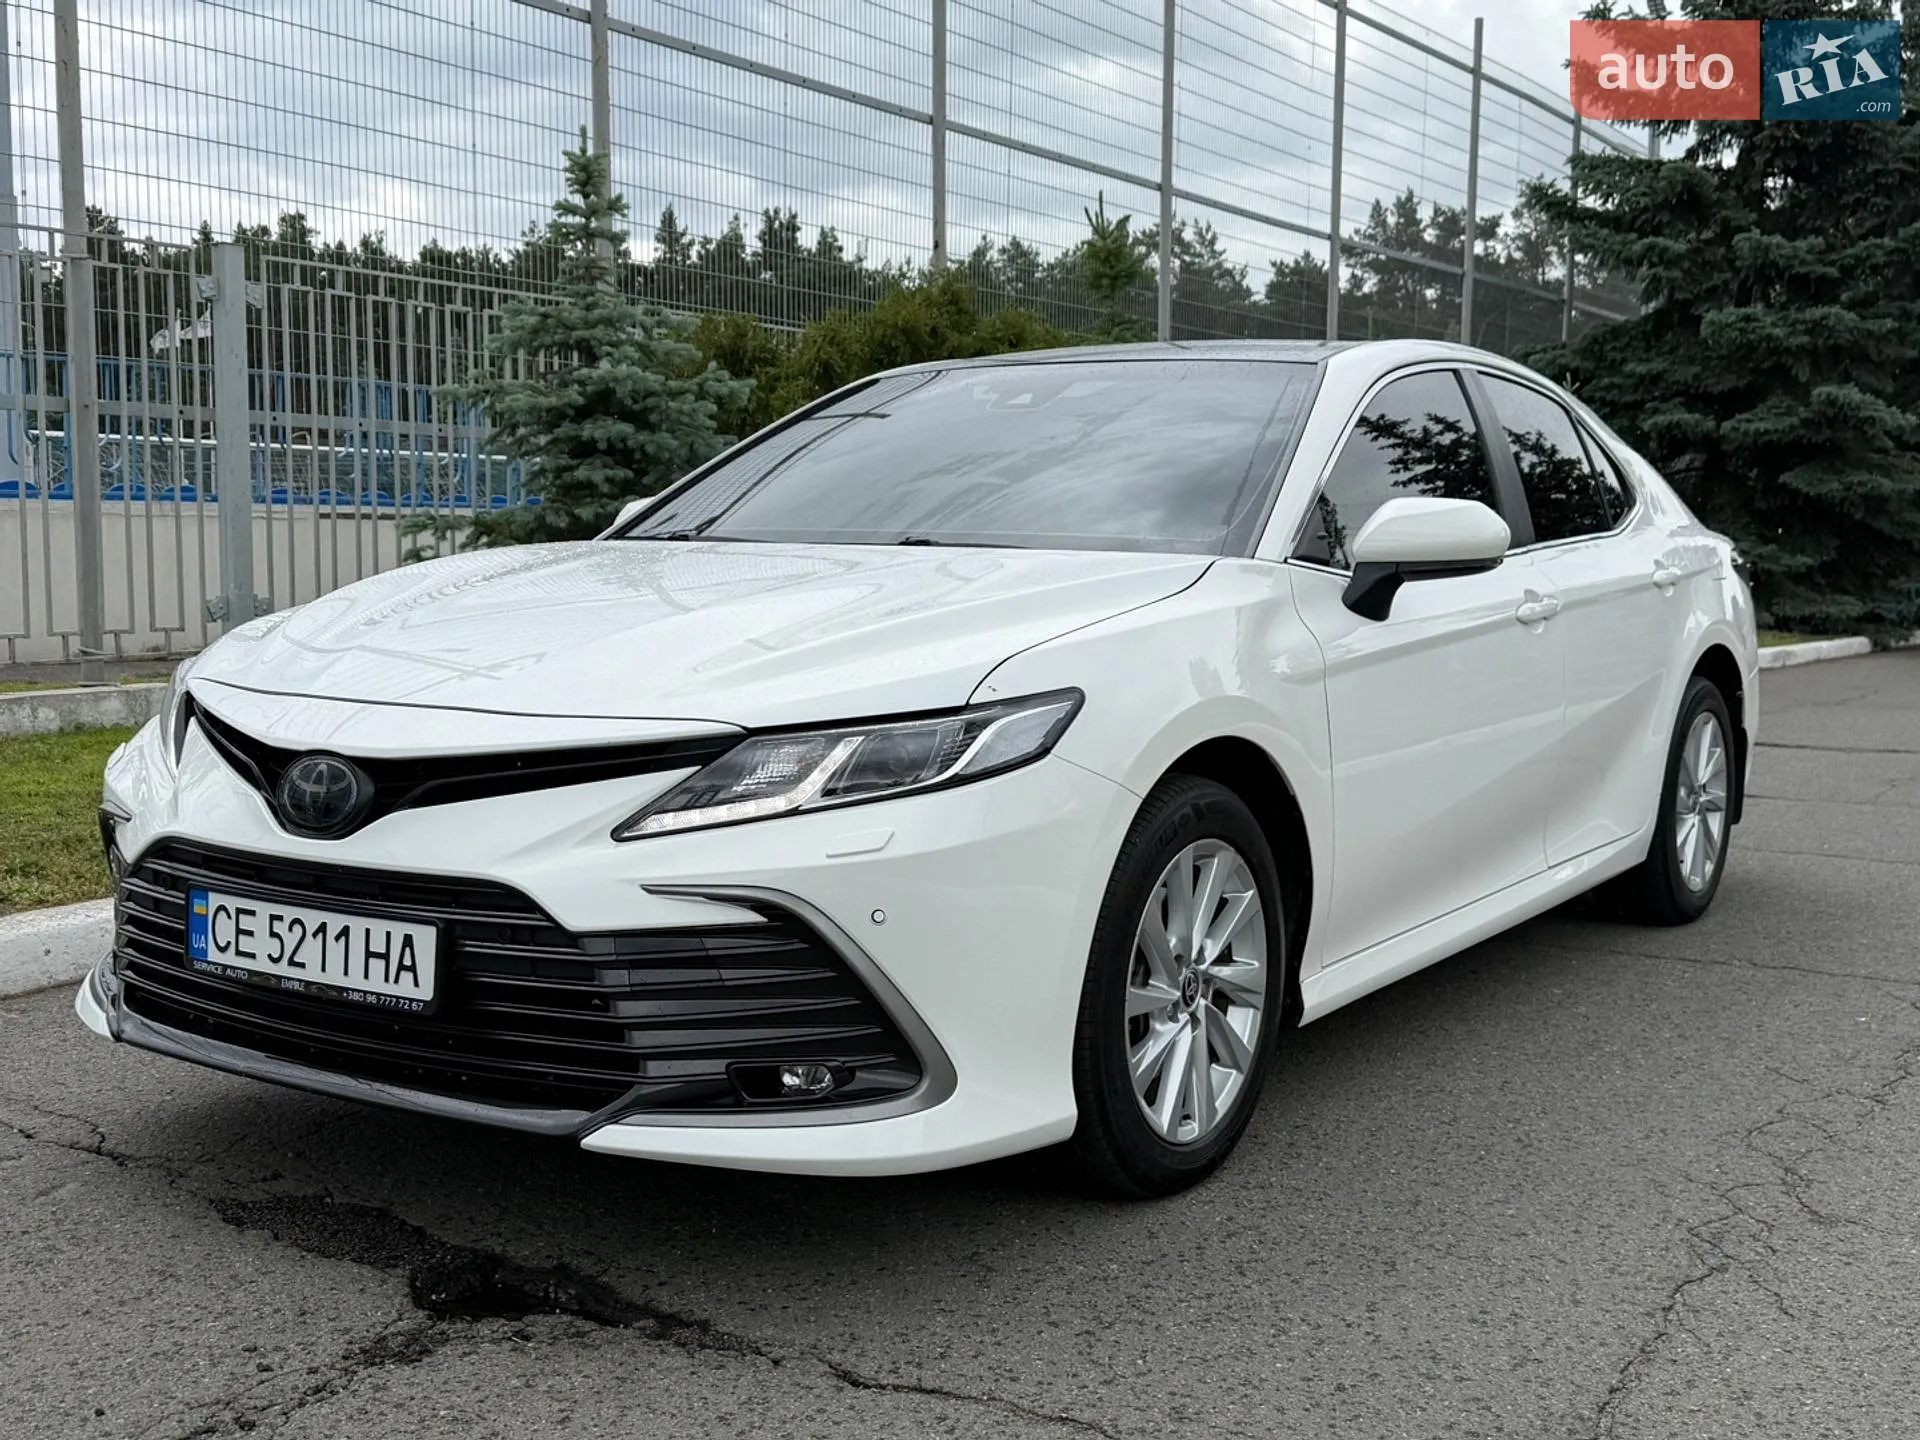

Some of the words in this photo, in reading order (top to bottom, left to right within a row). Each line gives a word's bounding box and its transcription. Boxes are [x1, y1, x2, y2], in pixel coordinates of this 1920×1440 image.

[191, 932, 207, 950] UA
[211, 903, 257, 960] CE
[266, 913, 351, 978] 5211
[363, 927, 420, 988] HA
[192, 960, 223, 975] SERVICE
[225, 967, 248, 980] AUTO
[342, 990, 364, 1002] +380
[365, 994, 378, 1005] 96
[379, 996, 396, 1008] 777
[397, 998, 410, 1010] 72
[411, 1001, 424, 1012] 67
